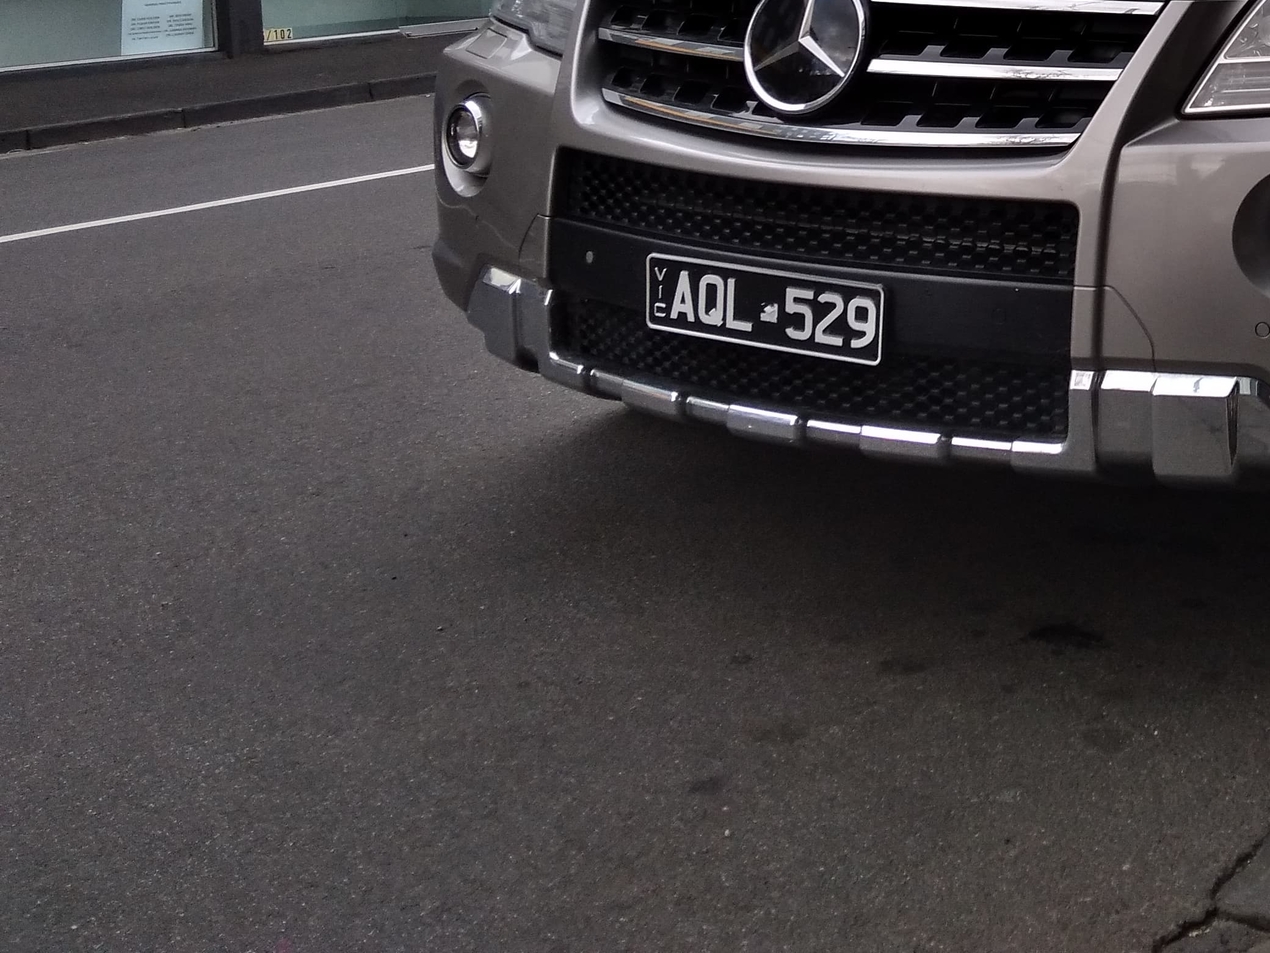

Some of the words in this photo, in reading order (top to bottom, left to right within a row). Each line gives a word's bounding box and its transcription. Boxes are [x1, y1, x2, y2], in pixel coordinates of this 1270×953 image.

[654, 266, 667, 317] VIC
[670, 270, 752, 332] AQL
[785, 286, 876, 348] 529
